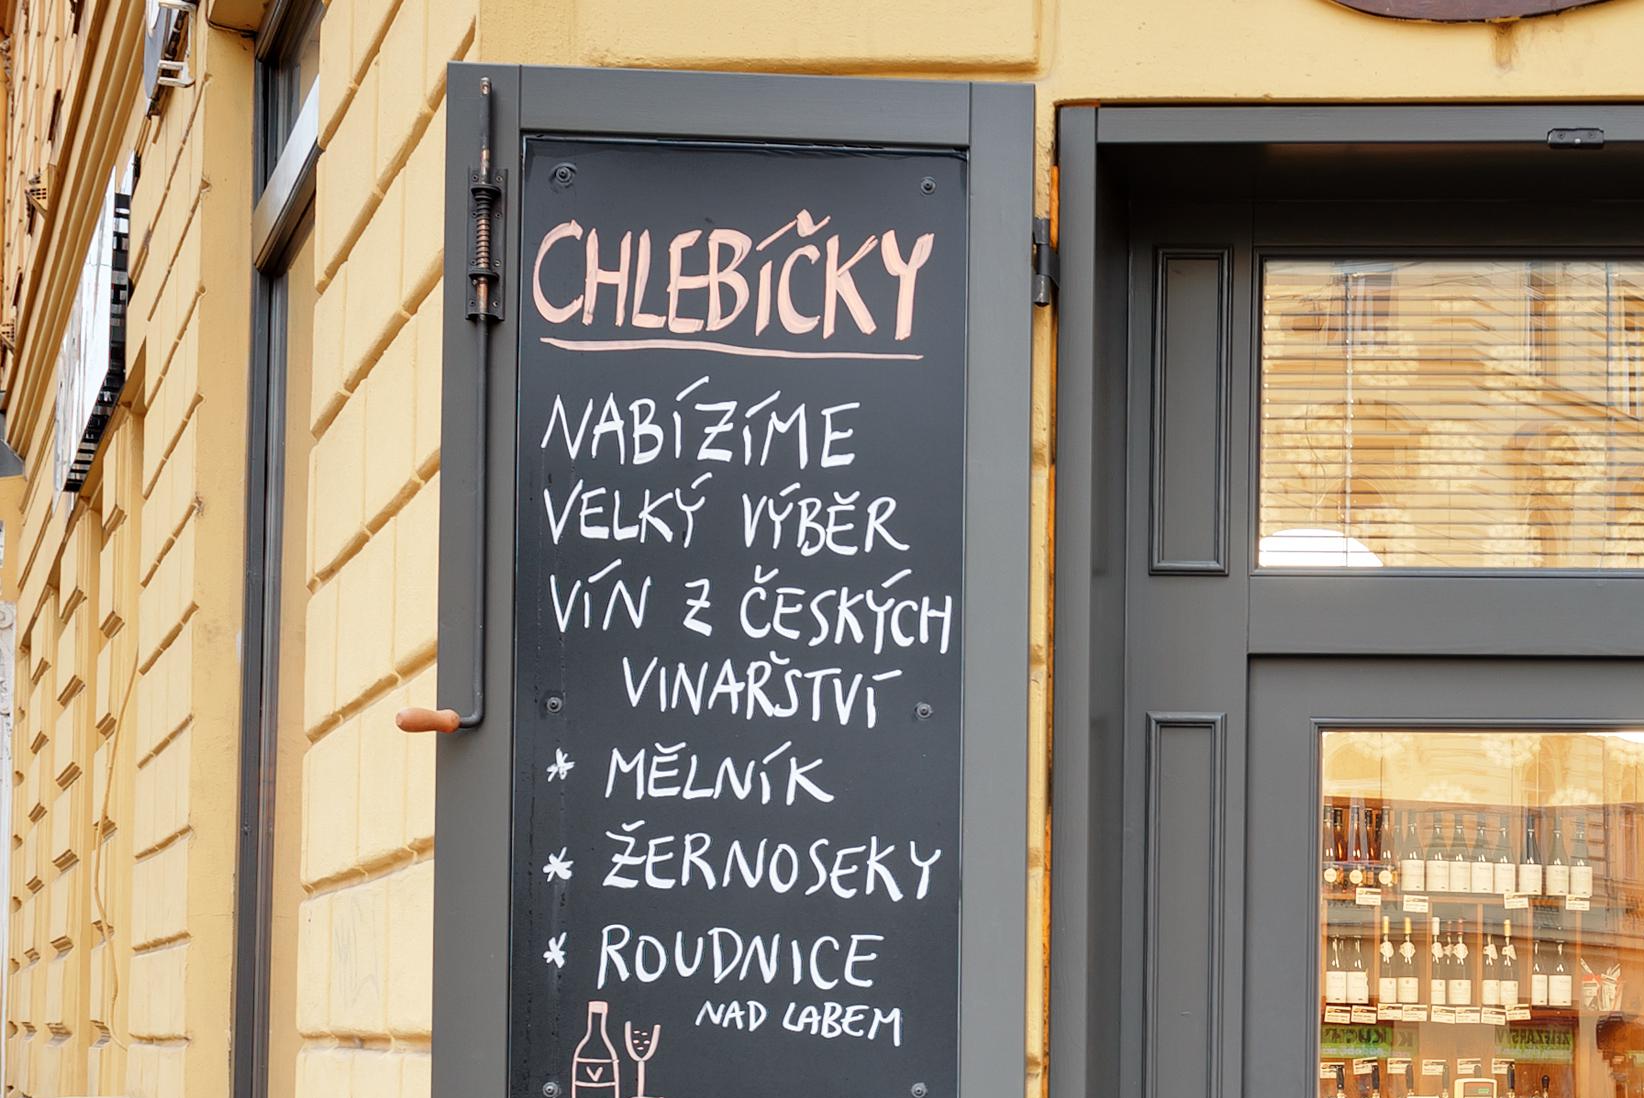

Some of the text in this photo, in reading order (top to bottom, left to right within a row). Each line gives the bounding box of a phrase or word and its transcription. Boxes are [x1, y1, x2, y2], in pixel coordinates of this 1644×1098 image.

[532, 208, 935, 341] CHLEBÍČKY
[540, 375, 861, 470] NABÍZÍME
[543, 471, 911, 557] VELKÝ VÝBĚR
[549, 558, 953, 655] VÍN Z ČESKÝCH
[622, 650, 903, 729] VINAŘSTVÍ
[604, 740, 835, 806] MĚLNÍK
[602, 819, 942, 903] ŽERNOSEKY
[597, 923, 885, 990] ROUDNICE
[694, 1000, 901, 1047] NAD LABEM
